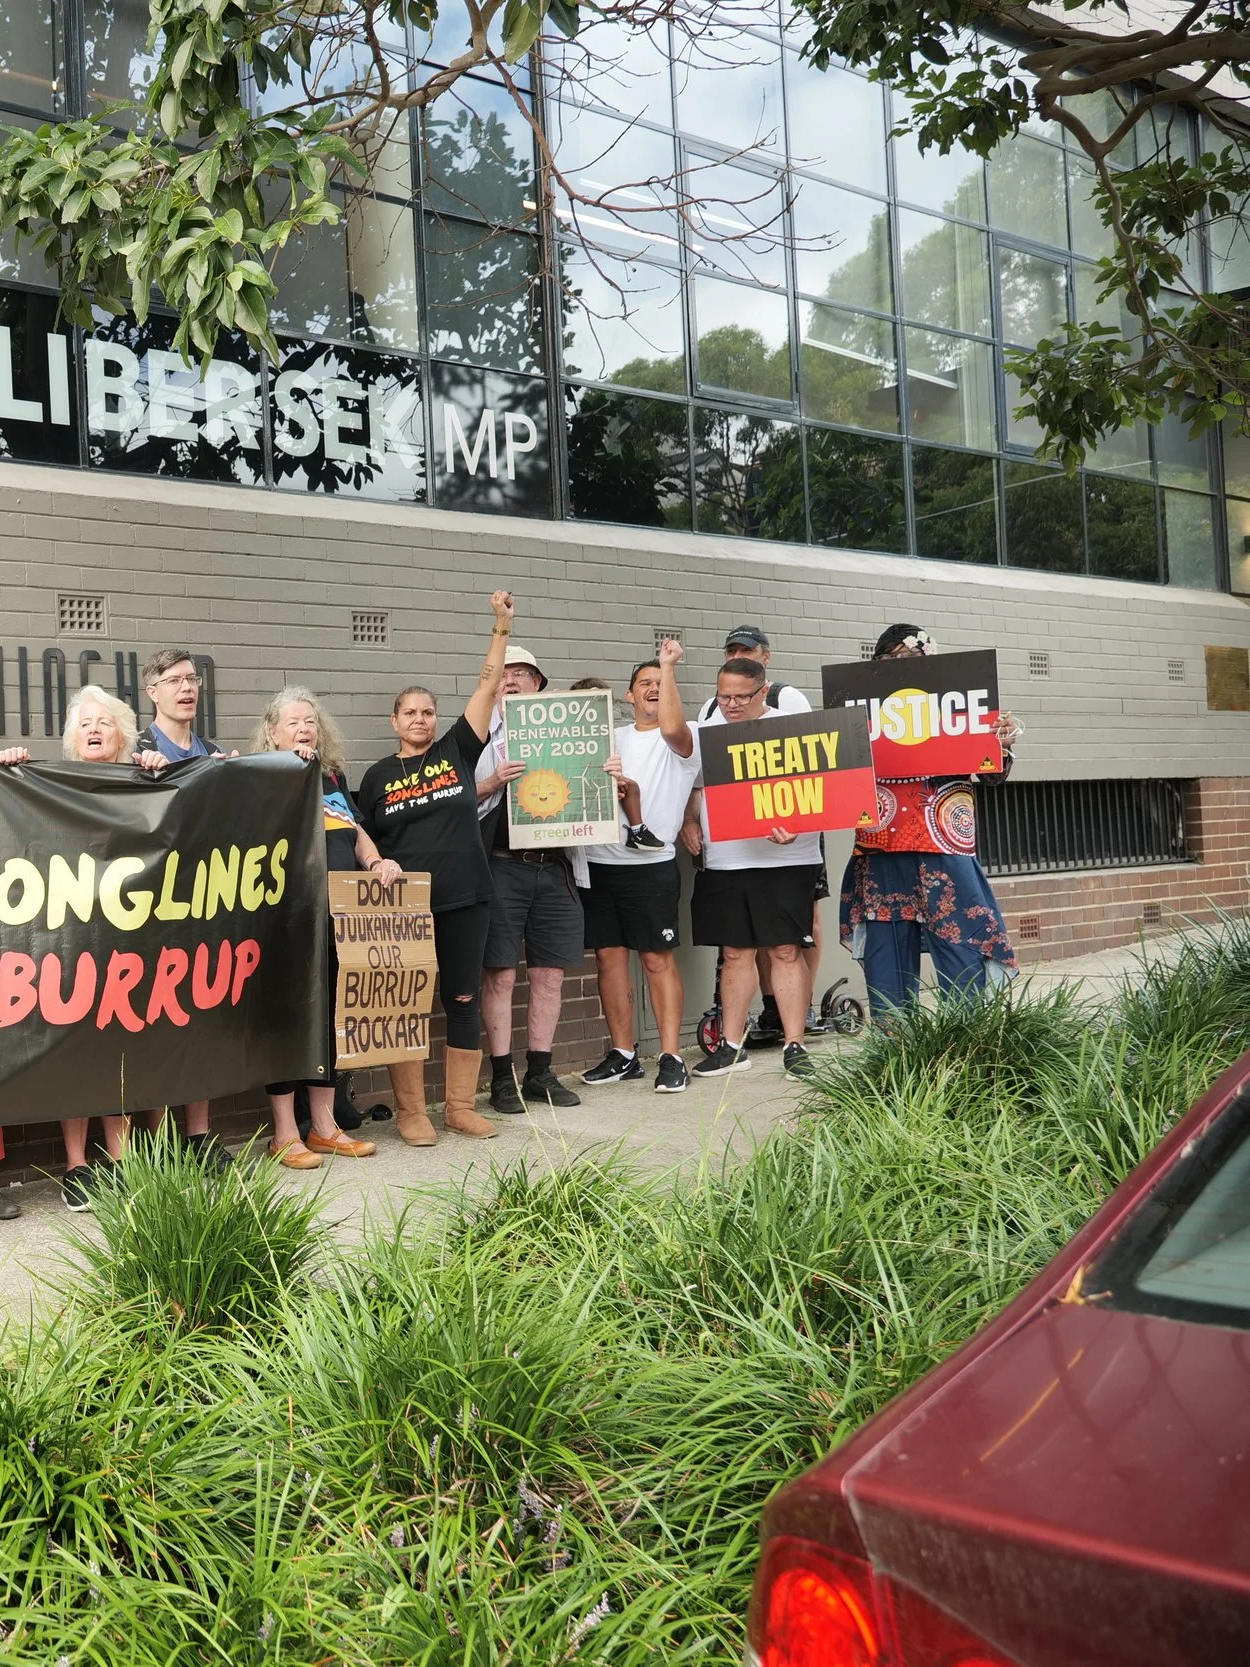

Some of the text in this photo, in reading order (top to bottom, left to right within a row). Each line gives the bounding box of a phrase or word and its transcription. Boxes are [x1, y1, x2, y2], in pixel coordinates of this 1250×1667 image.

[444, 403, 537, 479] MP
[516, 701, 598, 726] 100%
[845, 689, 990, 742] USTICE
[508, 725, 610, 741] RENEWABLES
[519, 743, 543, 758] BY
[551, 740, 598, 757] 2030
[727, 731, 839, 781] TREATY
[384, 760, 453, 793] SAVE OUR
[385, 770, 459, 805] SONGLINES
[385, 786, 464, 815] SAVE THE BURRUP
[752, 776, 824, 820] NOW
[534, 825, 594, 840] green left
[357, 879, 407, 907] DONT
[334, 913, 432, 943] JUUKAN GORGE
[368, 945, 404, 969] OUR
[344, 969, 428, 1009] BURRUP
[344, 1012, 429, 1054] ROCK ART
